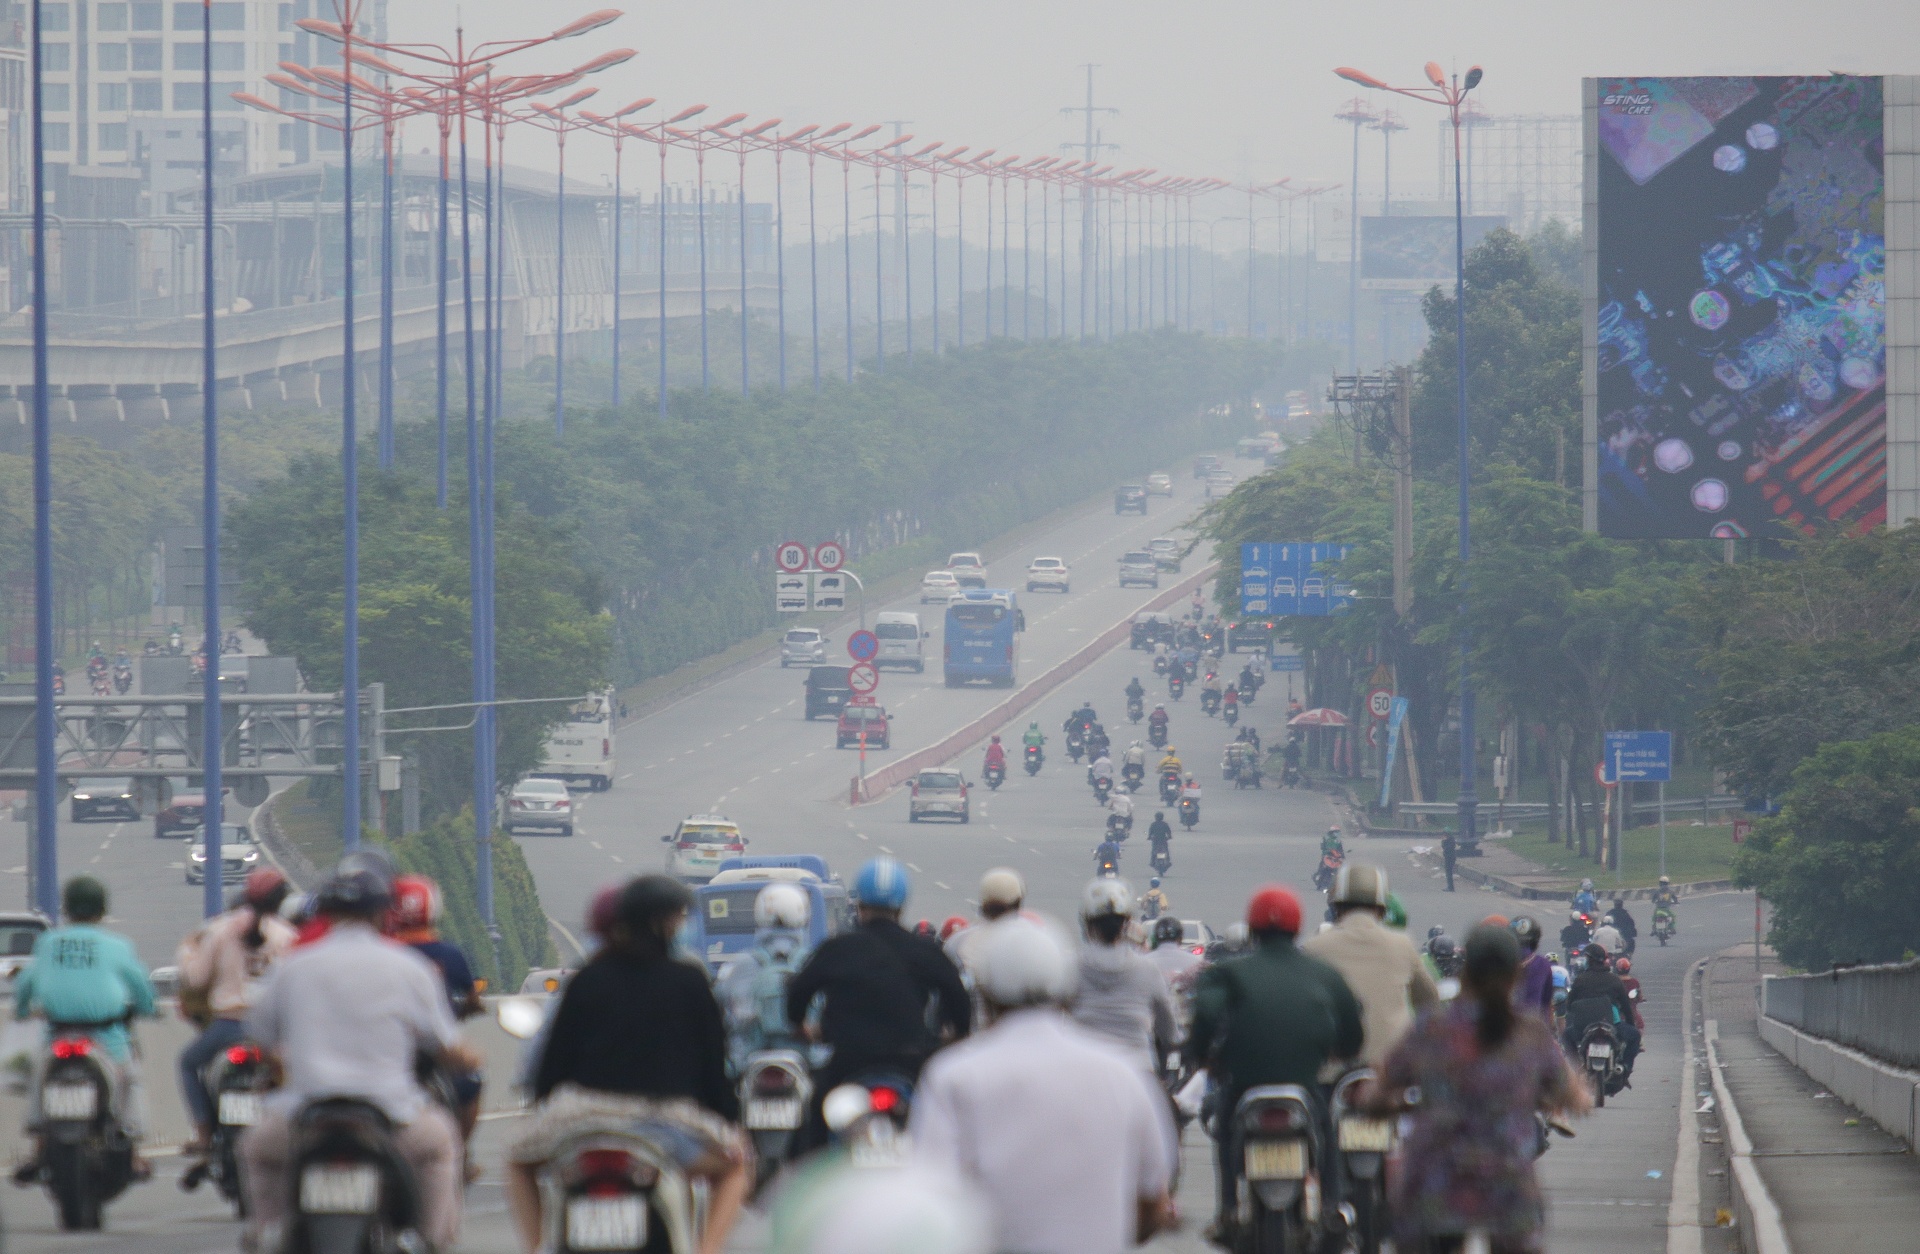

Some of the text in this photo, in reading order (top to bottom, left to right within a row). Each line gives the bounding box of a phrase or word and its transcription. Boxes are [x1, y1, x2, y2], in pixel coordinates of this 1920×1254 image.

[1603, 94, 1650, 105] STING
[786, 550, 798, 565] 80
[822, 550, 836, 564] 60
[1374, 696, 1390, 711] 50
